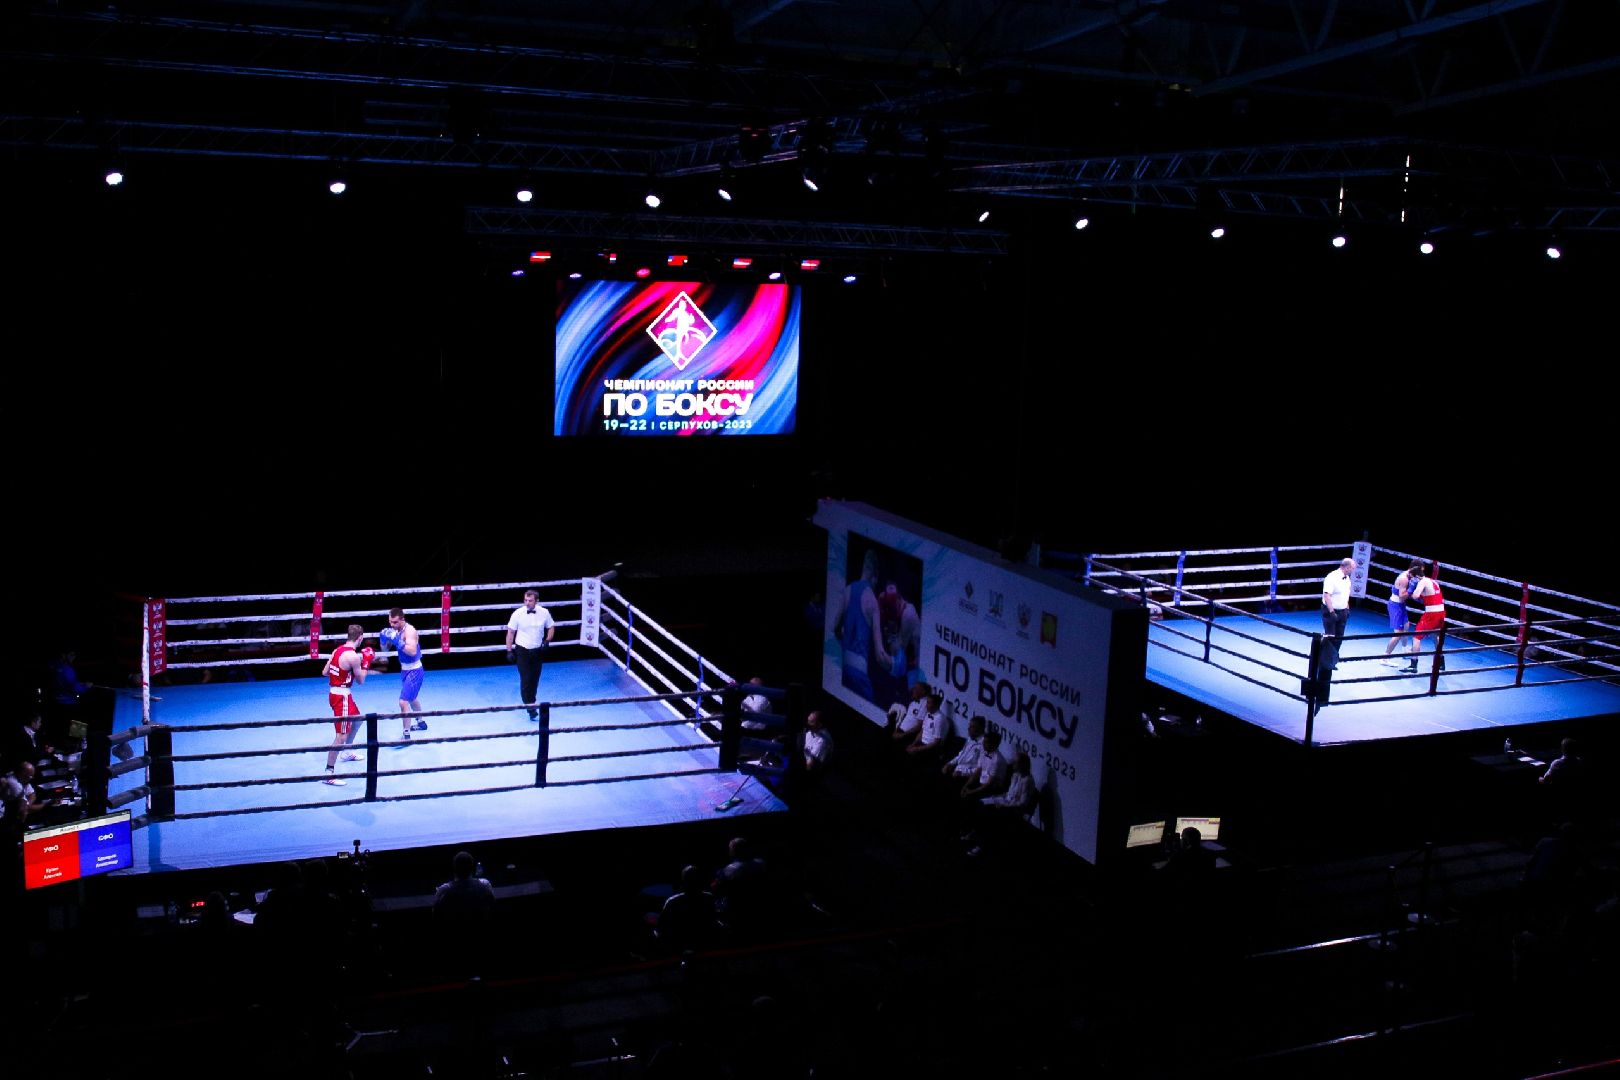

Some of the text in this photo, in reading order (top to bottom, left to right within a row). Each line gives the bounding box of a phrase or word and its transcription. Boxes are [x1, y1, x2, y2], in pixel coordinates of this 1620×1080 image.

[603, 393, 754, 416] ПО БОКСУ
[604, 379, 754, 391] ЧЕМПИОНАТ РОССИИ
[935, 623, 1081, 707] ЧЕМПИОНАТ РОССИИ
[934, 644, 1079, 748] ПО БОКСУ
